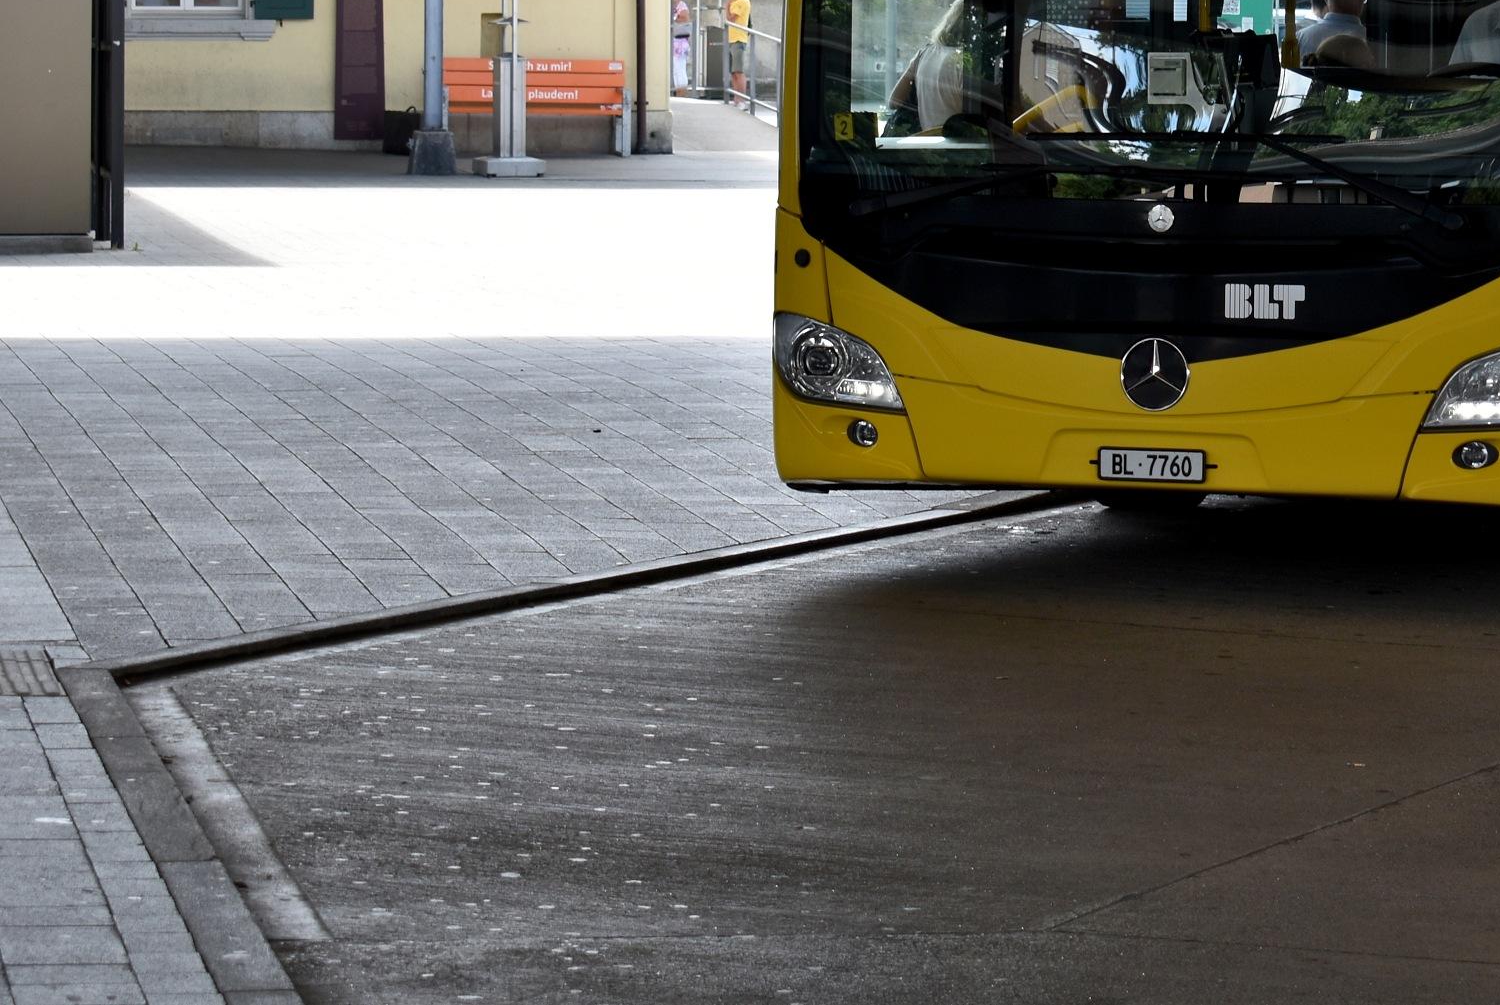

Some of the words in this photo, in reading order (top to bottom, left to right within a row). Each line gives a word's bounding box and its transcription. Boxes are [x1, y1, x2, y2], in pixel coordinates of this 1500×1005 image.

[536, 63, 549, 71] zu
[550, 61, 572, 71] mir!
[481, 88, 493, 98] La
[528, 90, 578, 100] plaudern!
[840, 121, 848, 135] 2
[1224, 283, 1306, 319] BLT
[1146, 454, 1192, 477] 7760
